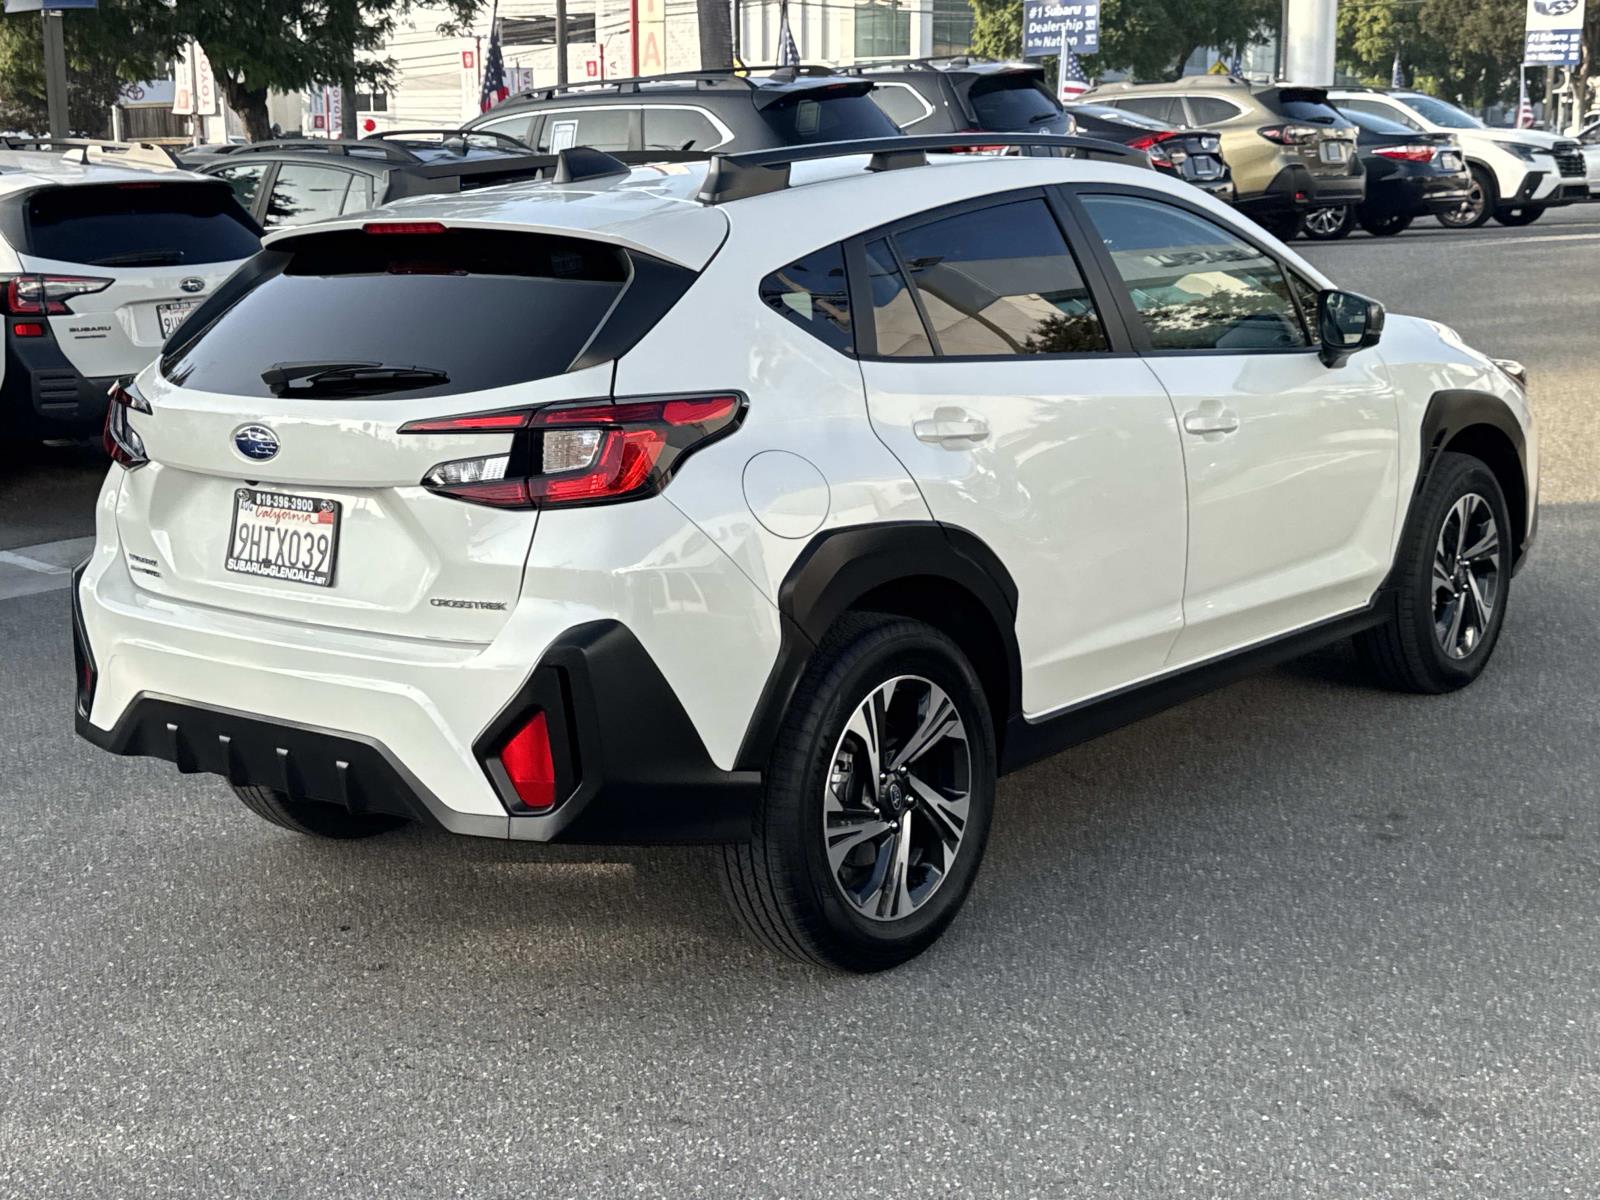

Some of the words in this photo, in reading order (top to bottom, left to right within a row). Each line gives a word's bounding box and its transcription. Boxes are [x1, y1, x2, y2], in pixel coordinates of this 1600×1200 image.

[1029, 6, 1042, 19] #1
[1044, 4, 1082, 17] Subaru
[1029, 19, 1083, 34] Dealership
[256, 493, 313, 511] 818-396-3900
[430, 599, 507, 611] CROSSTREK
